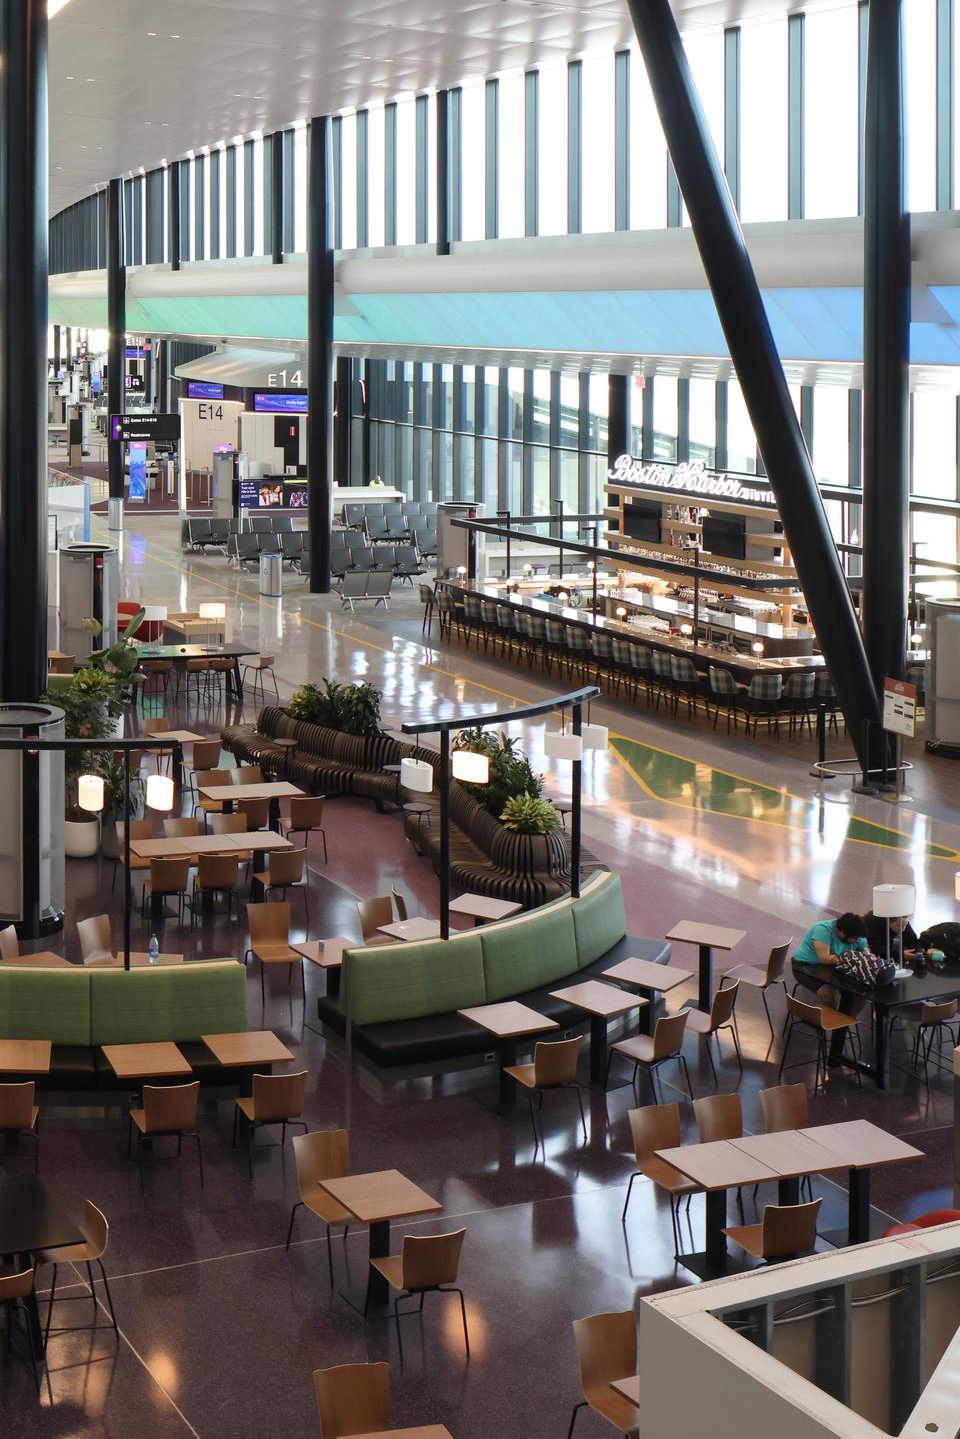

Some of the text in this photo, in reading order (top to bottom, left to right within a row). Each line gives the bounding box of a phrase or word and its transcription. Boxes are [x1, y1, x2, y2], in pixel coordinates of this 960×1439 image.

[268, 369, 304, 387] E14
[198, 403, 223, 421] E14
[608, 454, 675, 487] Boston
[673, 461, 742, 498] Harbor
